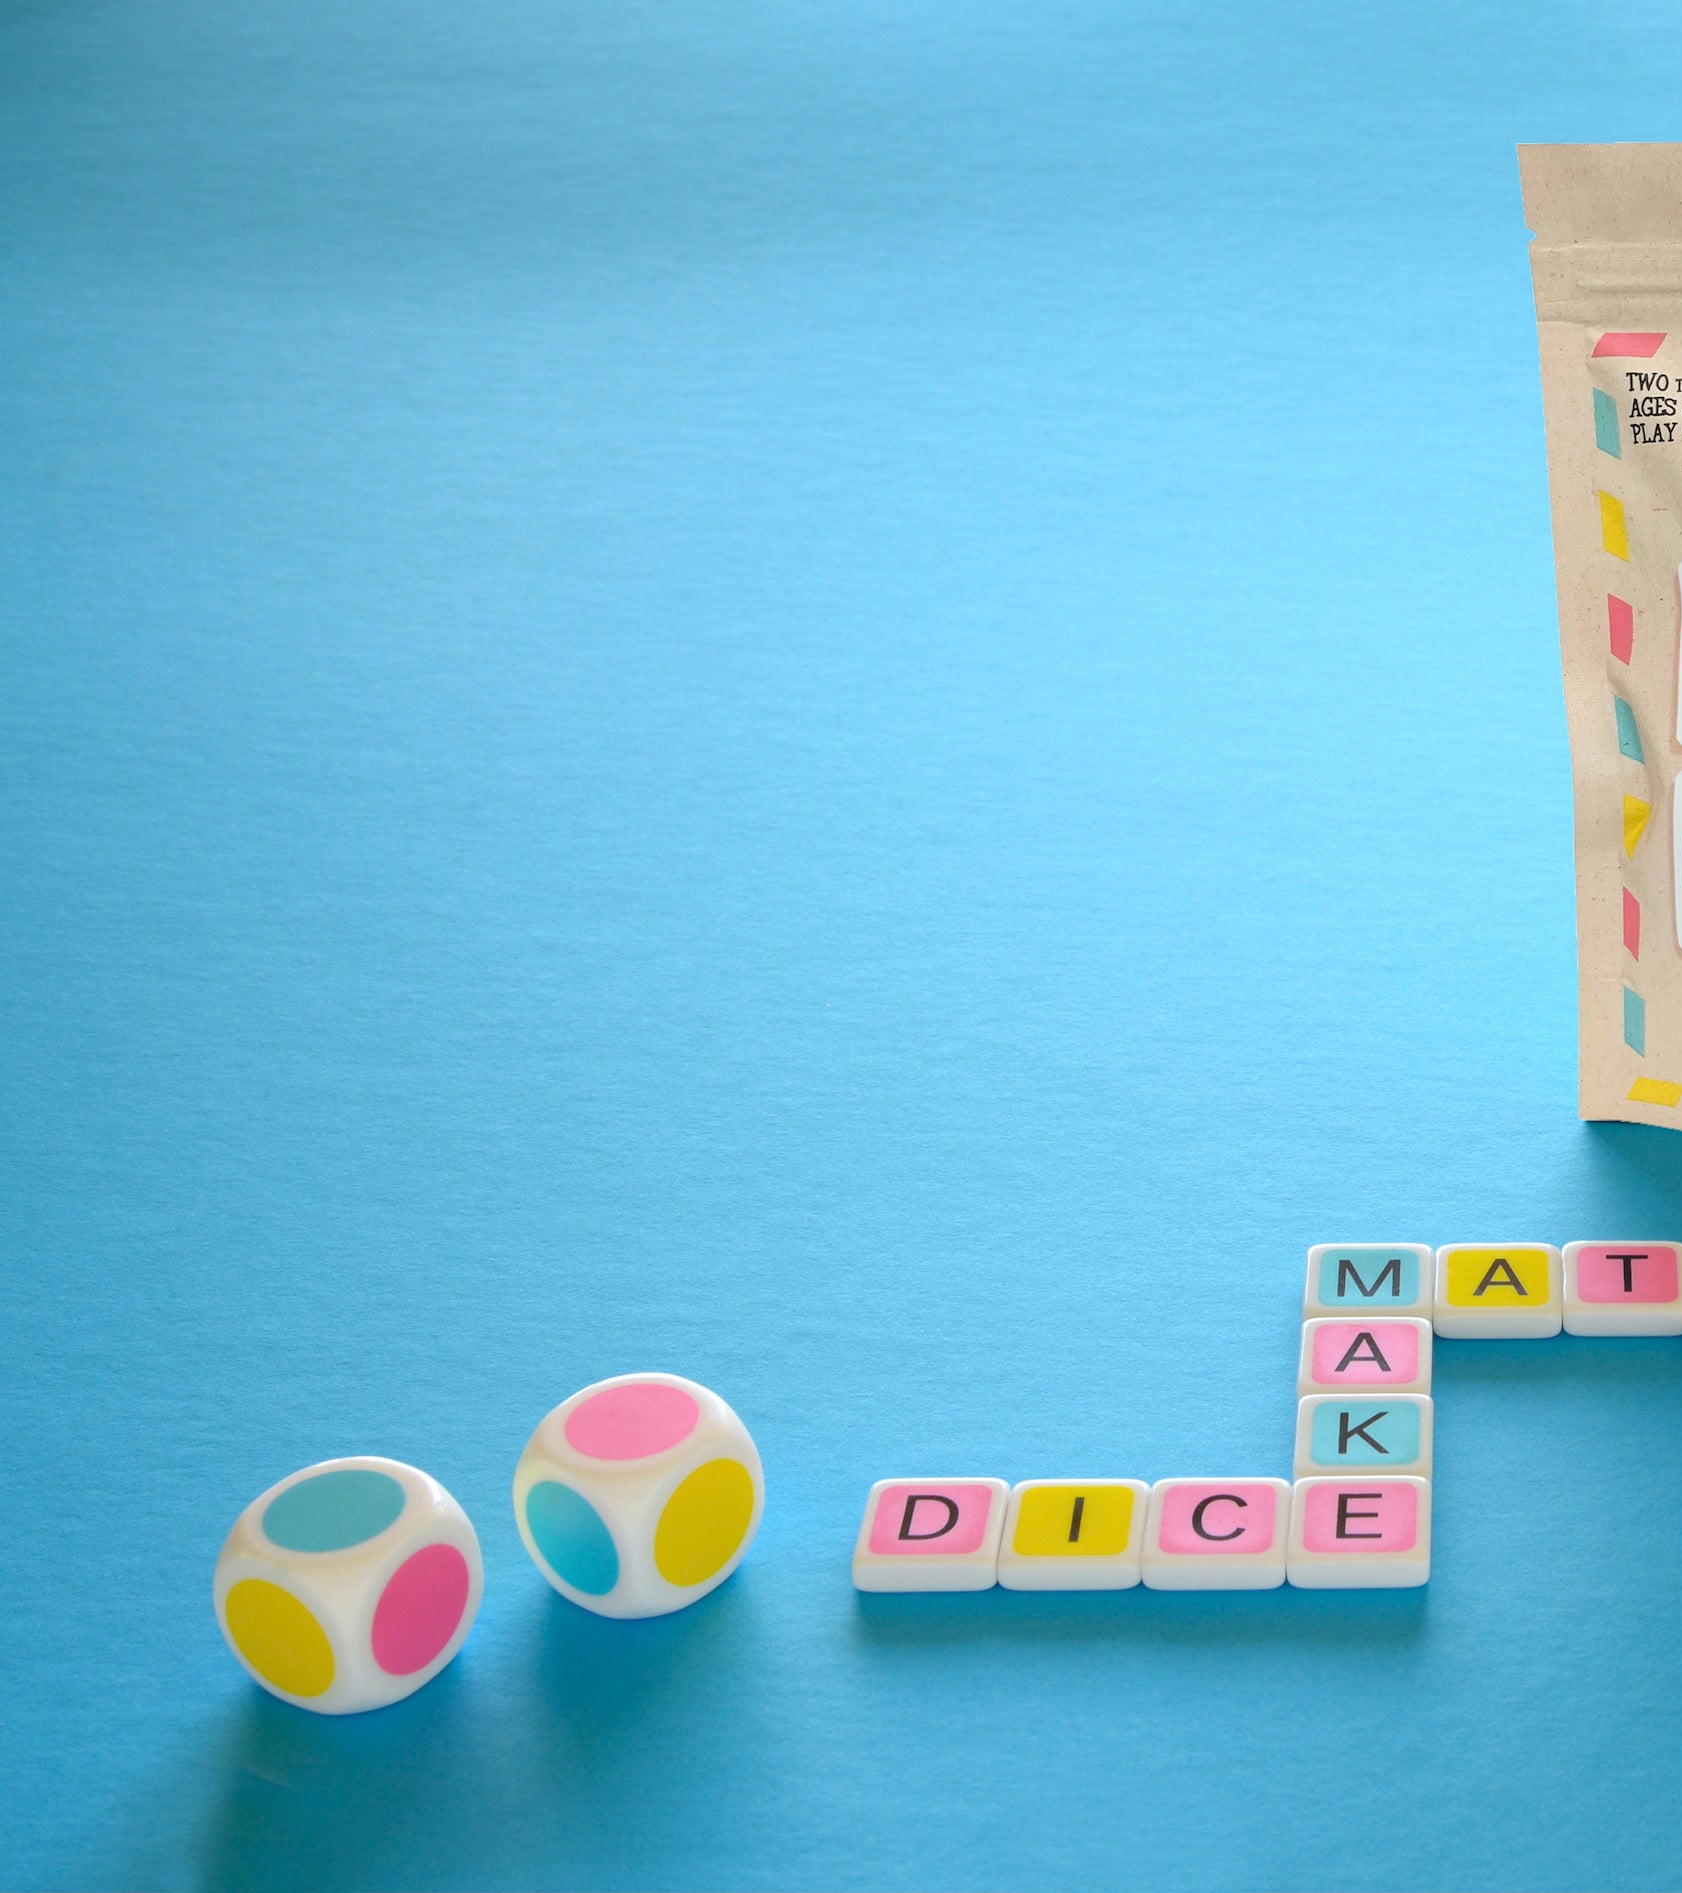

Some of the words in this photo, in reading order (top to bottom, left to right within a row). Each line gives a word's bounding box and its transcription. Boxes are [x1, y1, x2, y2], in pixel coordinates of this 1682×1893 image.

[1626, 372, 1669, 392] TWO
[1629, 397, 1676, 418] AGES
[1630, 422, 1678, 444] PLAY
[1334, 1258, 1402, 1540] MAKE
[897, 1493, 1384, 1543] DICE
